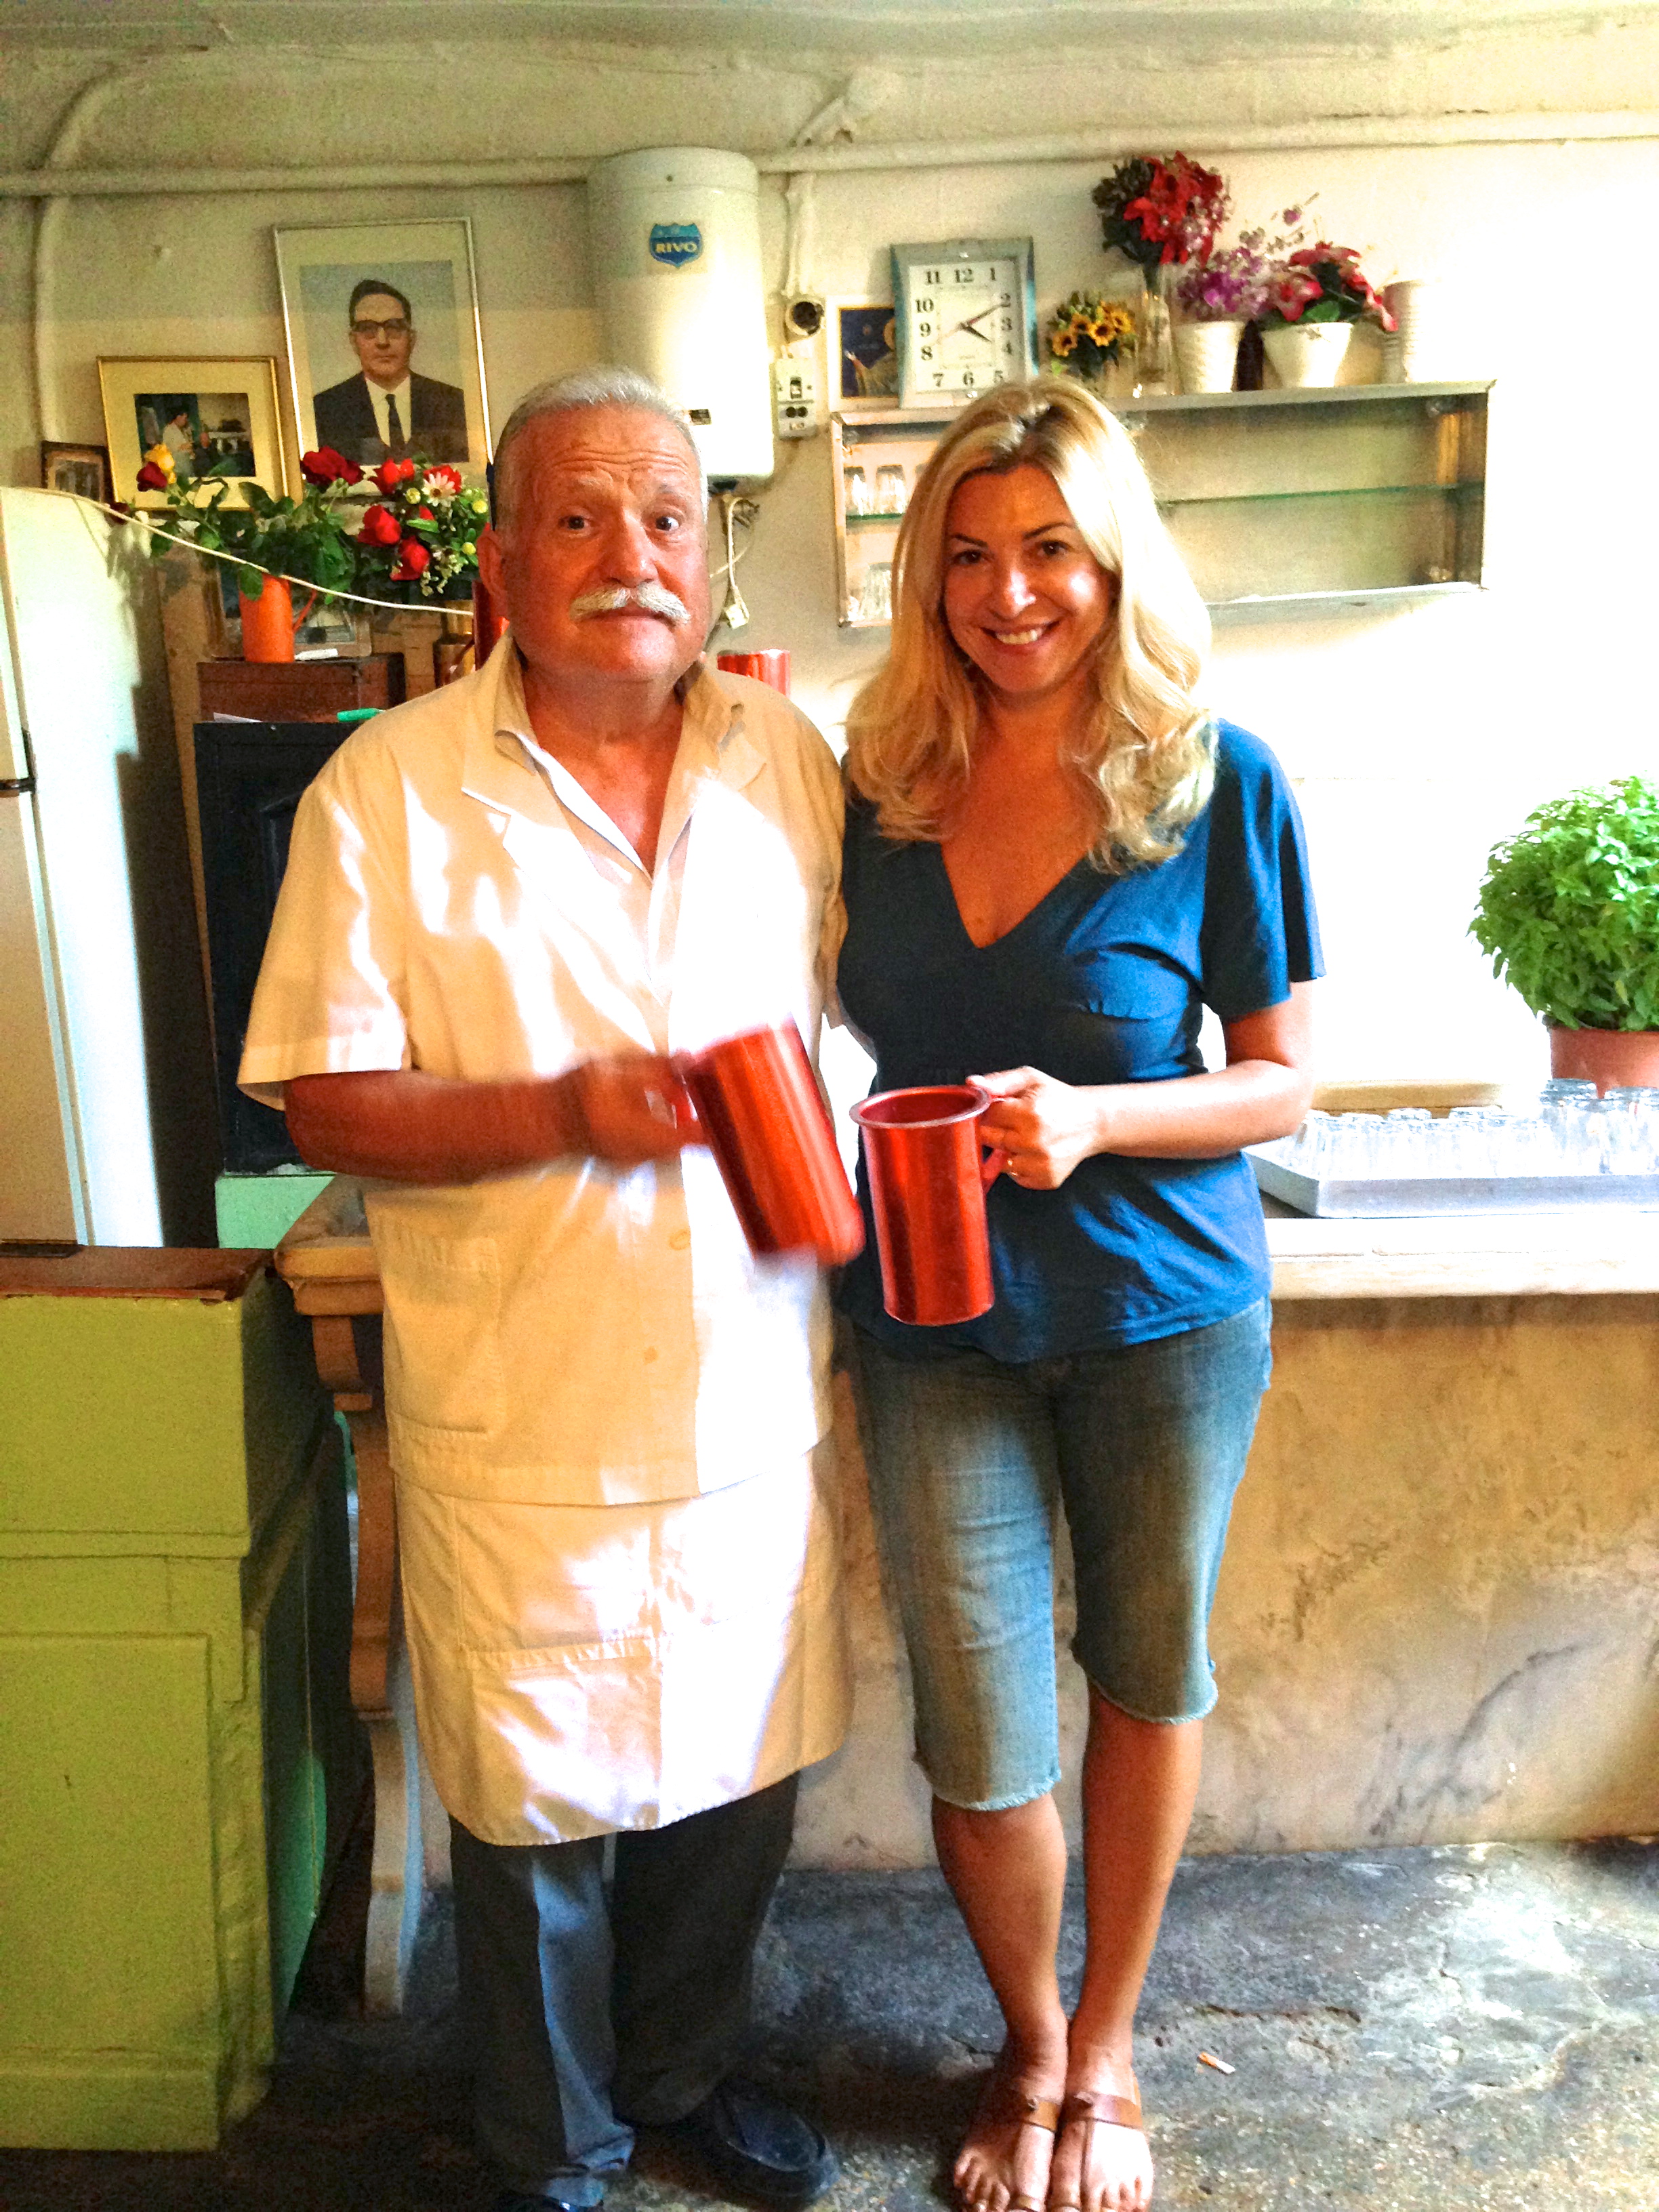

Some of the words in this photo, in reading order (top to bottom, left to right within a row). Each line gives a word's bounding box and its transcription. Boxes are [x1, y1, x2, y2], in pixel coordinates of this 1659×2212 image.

[655, 242, 697, 253] RIVO
[926, 271, 941, 284] 11
[954, 268, 975, 283] 12
[989, 268, 997, 281] 1
[916, 299, 934, 313] 10
[1000, 293, 1012, 308] 2
[920, 322, 931, 337] 9
[1001, 317, 1012, 331] 3
[920, 345, 933, 361] 8
[1002, 340, 1014, 356] 4
[933, 373, 944, 387] 7
[962, 371, 975, 387] 6
[993, 371, 1004, 384] 5
